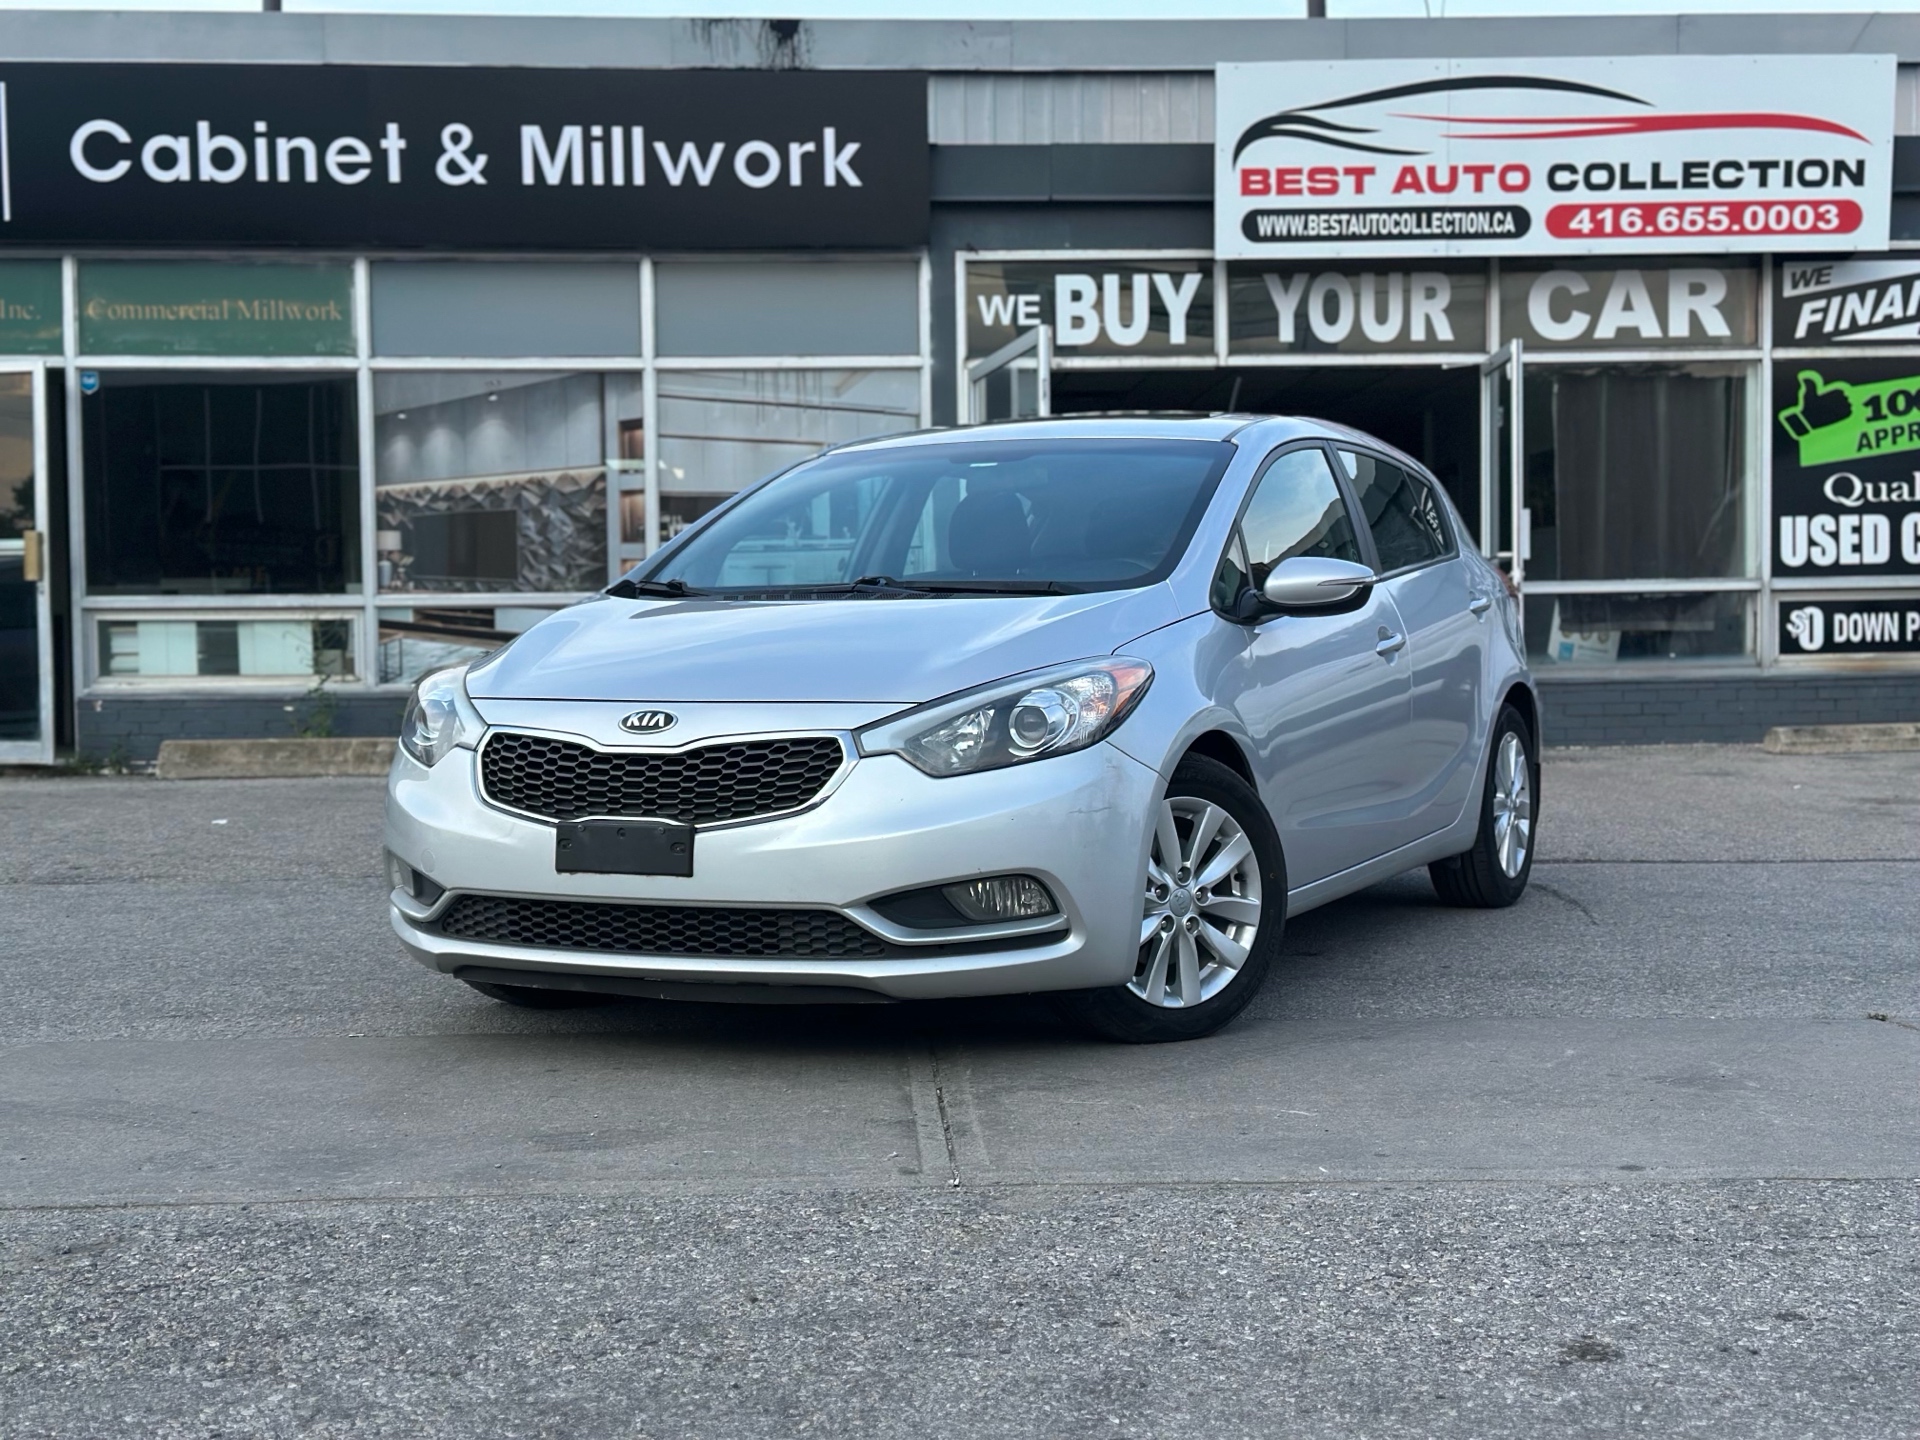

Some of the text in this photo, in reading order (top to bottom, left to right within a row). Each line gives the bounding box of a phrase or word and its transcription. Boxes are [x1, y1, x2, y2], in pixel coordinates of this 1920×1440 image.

[69, 118, 863, 188] Cabinet & Millwork
[1240, 159, 1865, 196] BEST AUTO COLLECTION
[1257, 211, 1516, 238] WWW.BESTAUTOCOLLECTION.CA
[1568, 203, 1840, 235] 416.655.0003
[1789, 265, 1833, 291] WE
[86, 298, 343, 321] Commercial Millwork
[977, 267, 1732, 346] WE BUY YOUR CAR
[1862, 388, 1920, 422] 10
[1780, 513, 1891, 567] USED
[1785, 606, 1920, 651] $0 DOWN P
[626, 712, 666, 727] KIA
